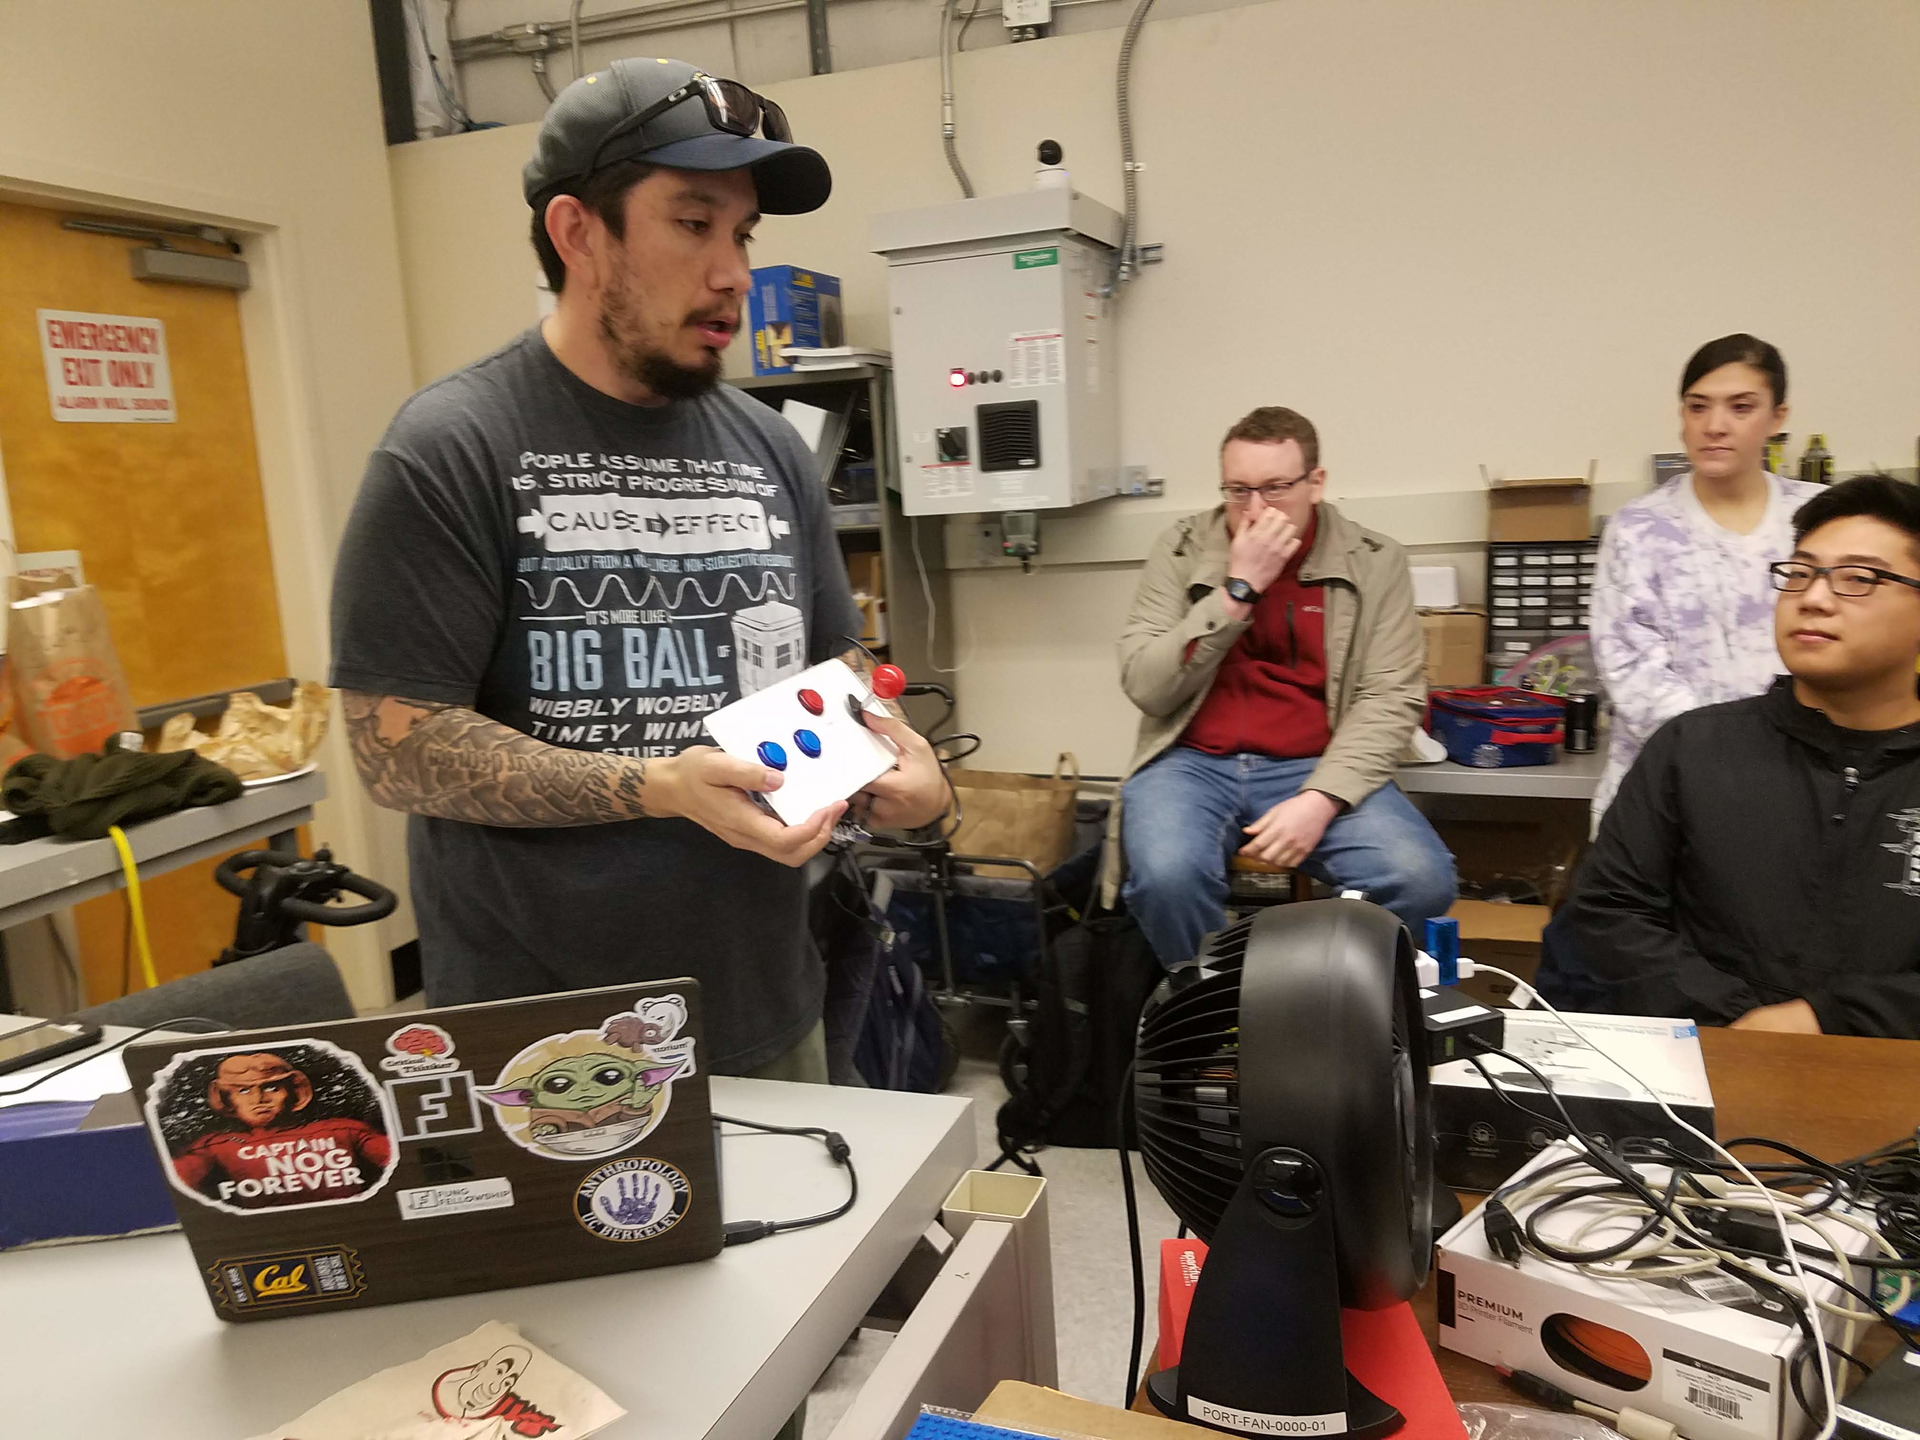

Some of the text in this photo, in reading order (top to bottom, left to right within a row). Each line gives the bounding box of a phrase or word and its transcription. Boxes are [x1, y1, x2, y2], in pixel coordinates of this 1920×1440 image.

[46, 319, 160, 355] EMERGENCY
[61, 357, 155, 388] EXIT ONLY
[600, 453, 681, 472] ASSUME
[682, 458, 727, 474] THAT
[511, 473, 538, 490] IS
[547, 470, 622, 489] STRICT
[755, 483, 779, 497] OF
[548, 509, 760, 535] CAUSE EFFECT
[609, 609, 640, 625] MORE
[527, 629, 604, 692] BIG
[622, 627, 724, 689] BALL
[528, 691, 729, 718] WIBBLY WOBBLY
[531, 720, 711, 743] TIMEY WIM
[237, 1137, 336, 1160] CAPTAIN
[266, 1149, 352, 1177] NOG
[217, 1167, 365, 1200] FOREVER
[579, 1159, 689, 1198] ANTHROPOLOGY
[439, 1190, 511, 1206] FELLOWSHIP
[581, 1209, 680, 1240] UC BERKELEY
[253, 1263, 309, 1295] Cal
[1457, 1290, 1524, 1322] PREMIUM
[1470, 1306, 1497, 1321] Printer
[1498, 1315, 1534, 1336] Filament
[1203, 1406, 1327, 1432] PORT-FAN-0000-01
